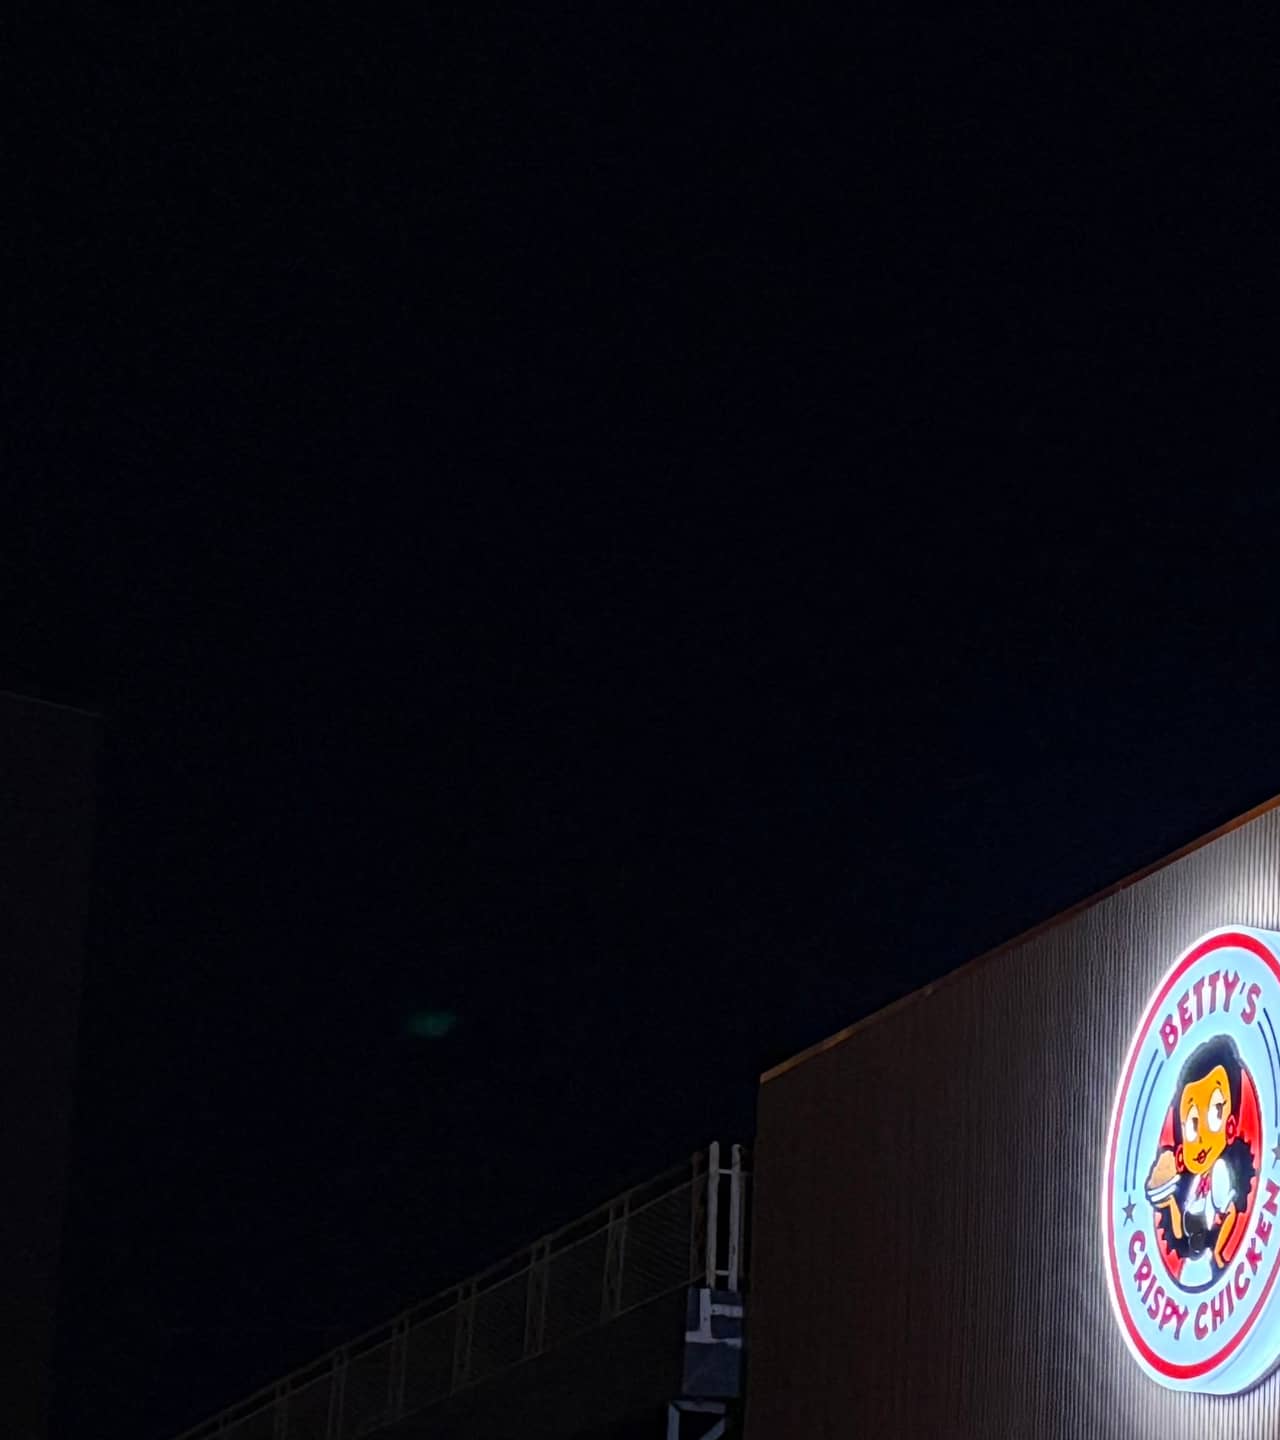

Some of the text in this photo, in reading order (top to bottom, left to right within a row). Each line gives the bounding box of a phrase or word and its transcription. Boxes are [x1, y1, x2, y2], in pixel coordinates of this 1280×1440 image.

[1159, 970, 1261, 1058] BETTY'S
[1127, 1182, 1280, 1341] CRISPY CHICKEN
